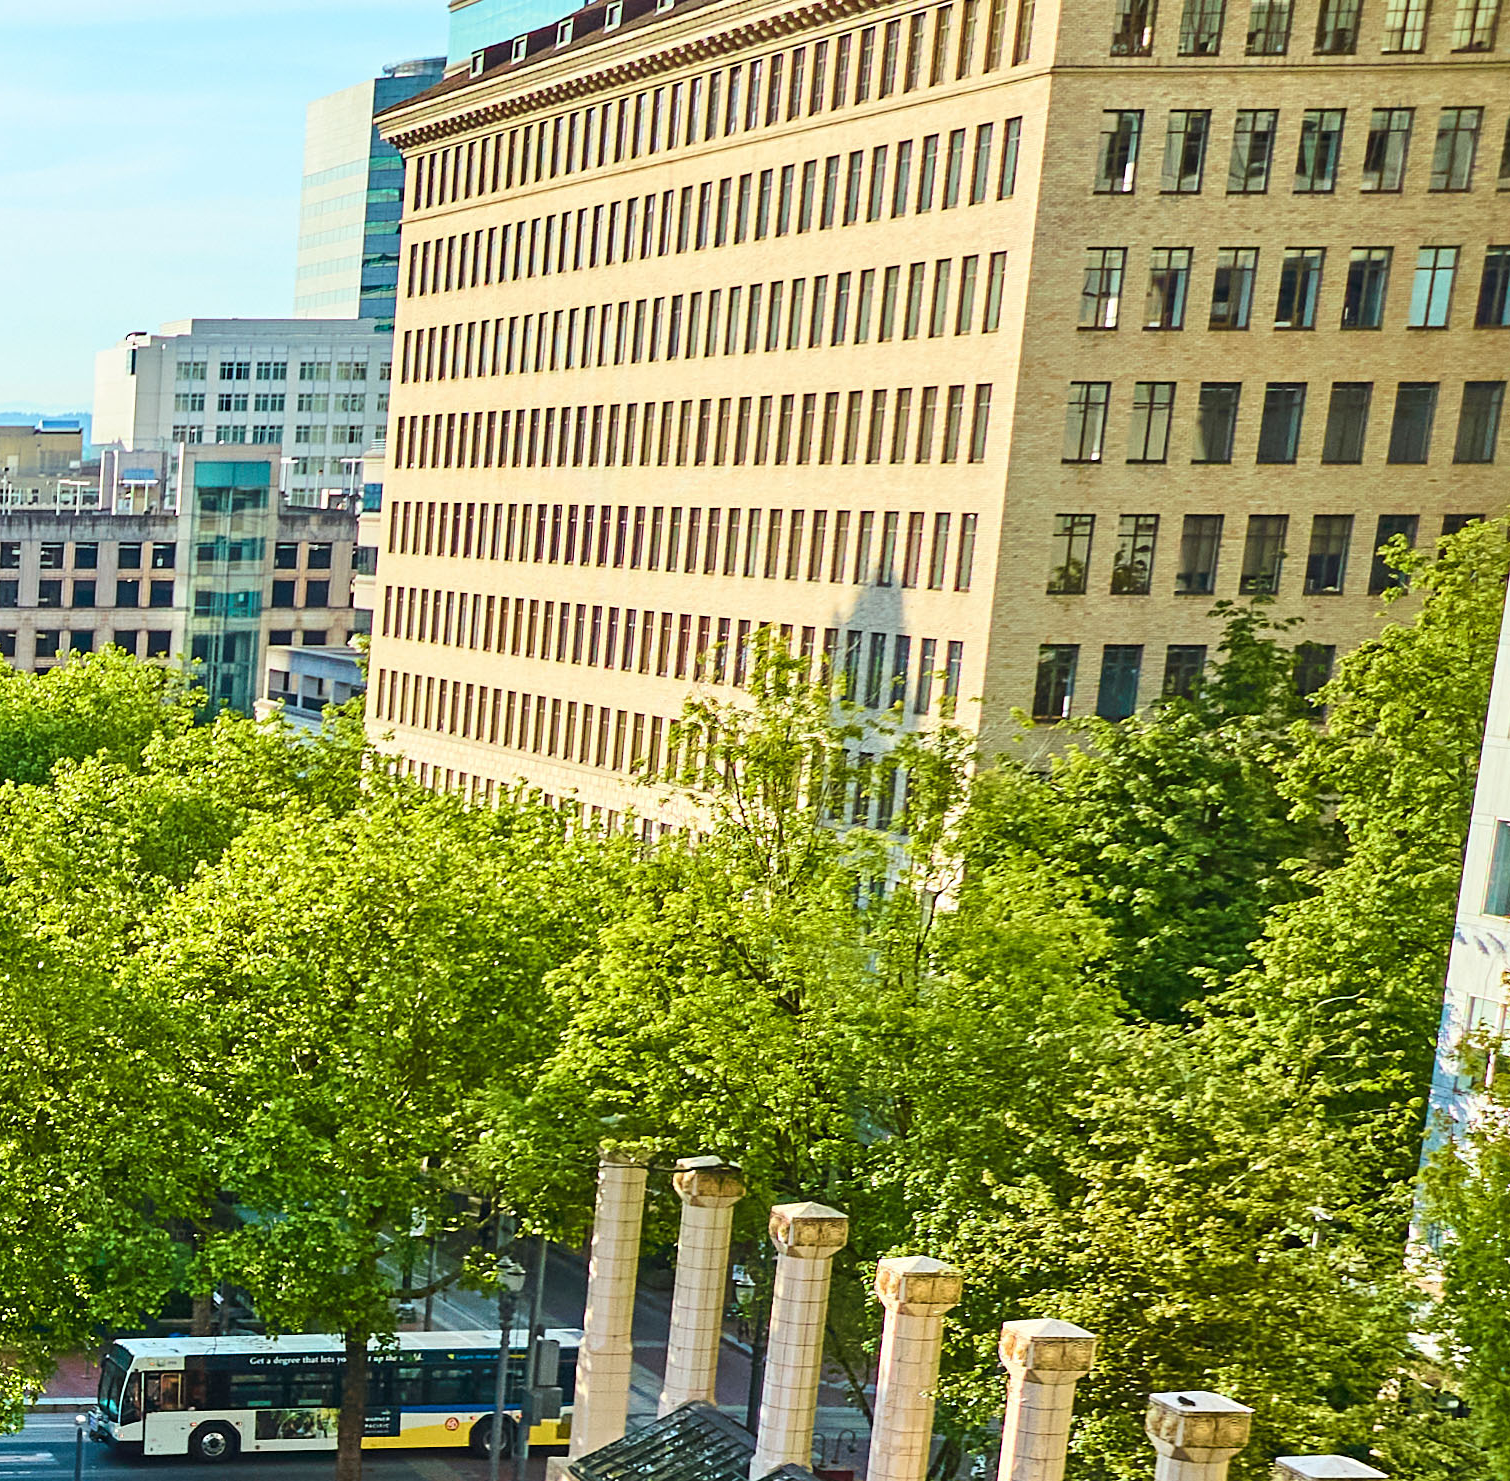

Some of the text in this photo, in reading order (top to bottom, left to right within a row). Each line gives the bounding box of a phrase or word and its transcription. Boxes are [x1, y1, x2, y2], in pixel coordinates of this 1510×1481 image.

[249, 1356, 264, 1365] Get
[273, 1355, 300, 1366] degree
[302, 1355, 319, 1364] that
[320, 1354, 335, 1364] lets
[336, 1356, 347, 1366] yo
